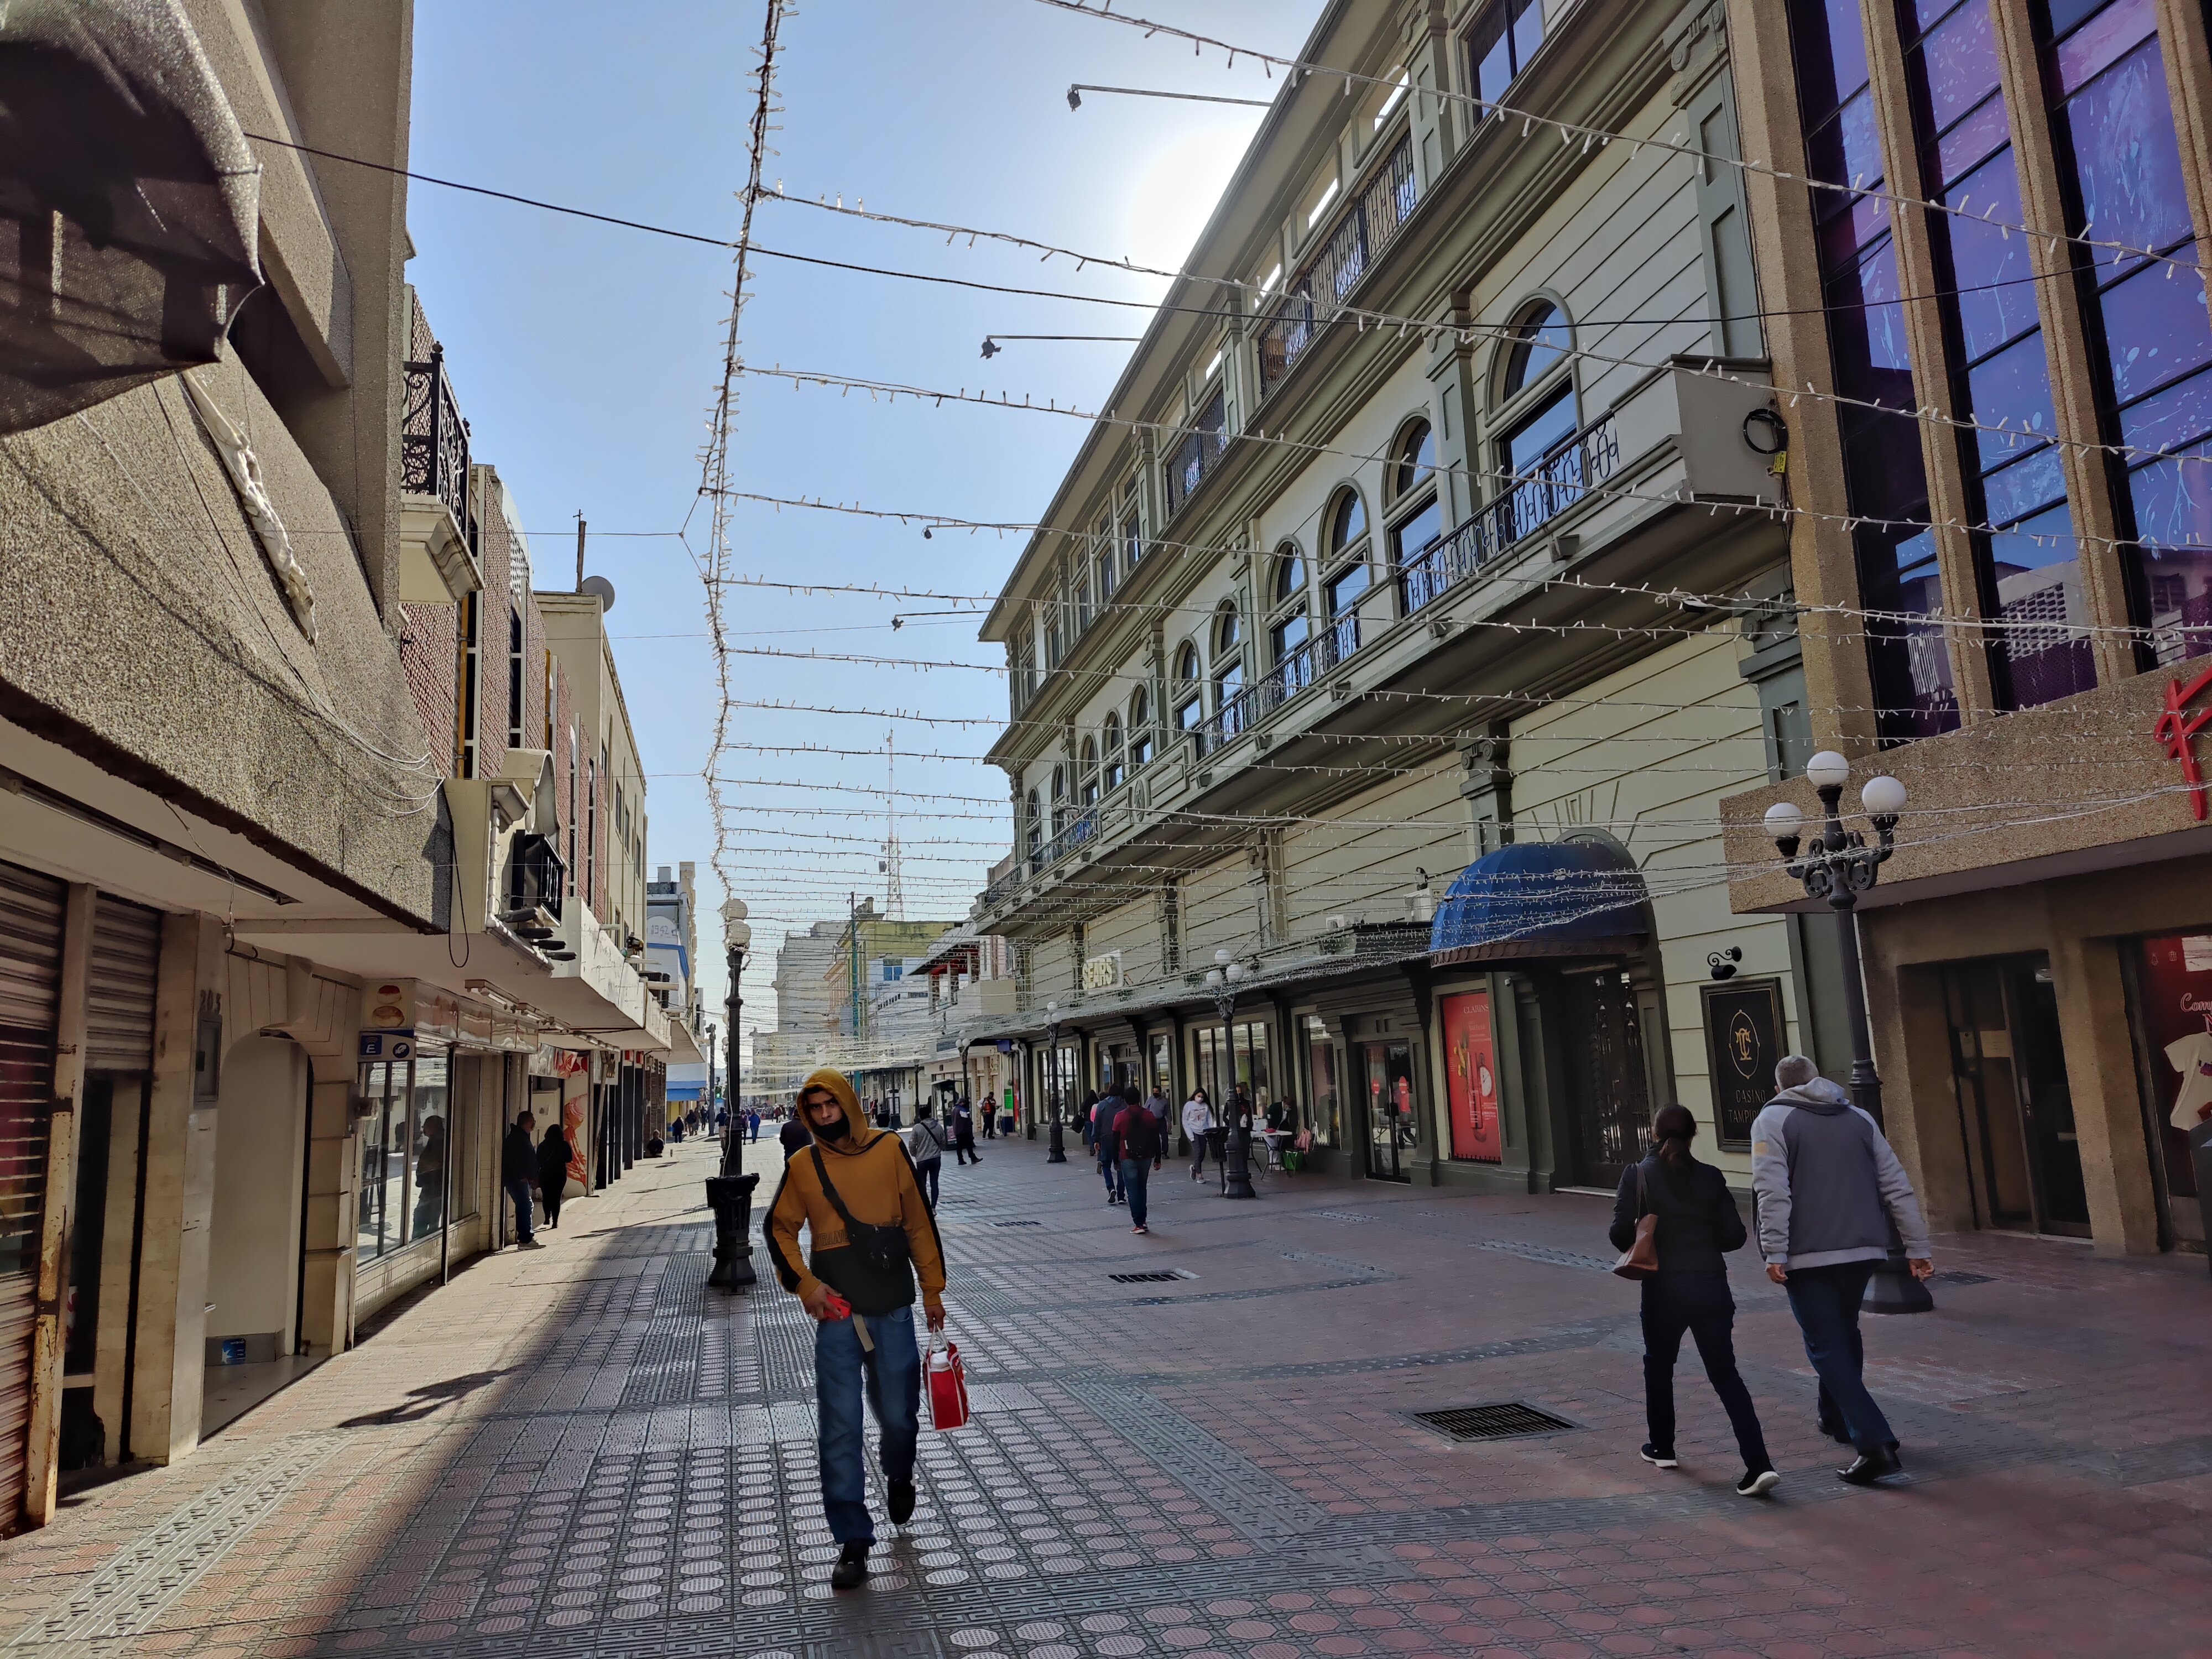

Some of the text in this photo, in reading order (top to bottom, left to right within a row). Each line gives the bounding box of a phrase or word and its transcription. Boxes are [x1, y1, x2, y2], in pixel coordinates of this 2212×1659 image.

[651, 925, 669, 935] 1942
[1082, 958, 1112, 990] SEARS
[1463, 1004, 1489, 1014] CLARINS
[1736, 1089, 1766, 1103] CASINO
